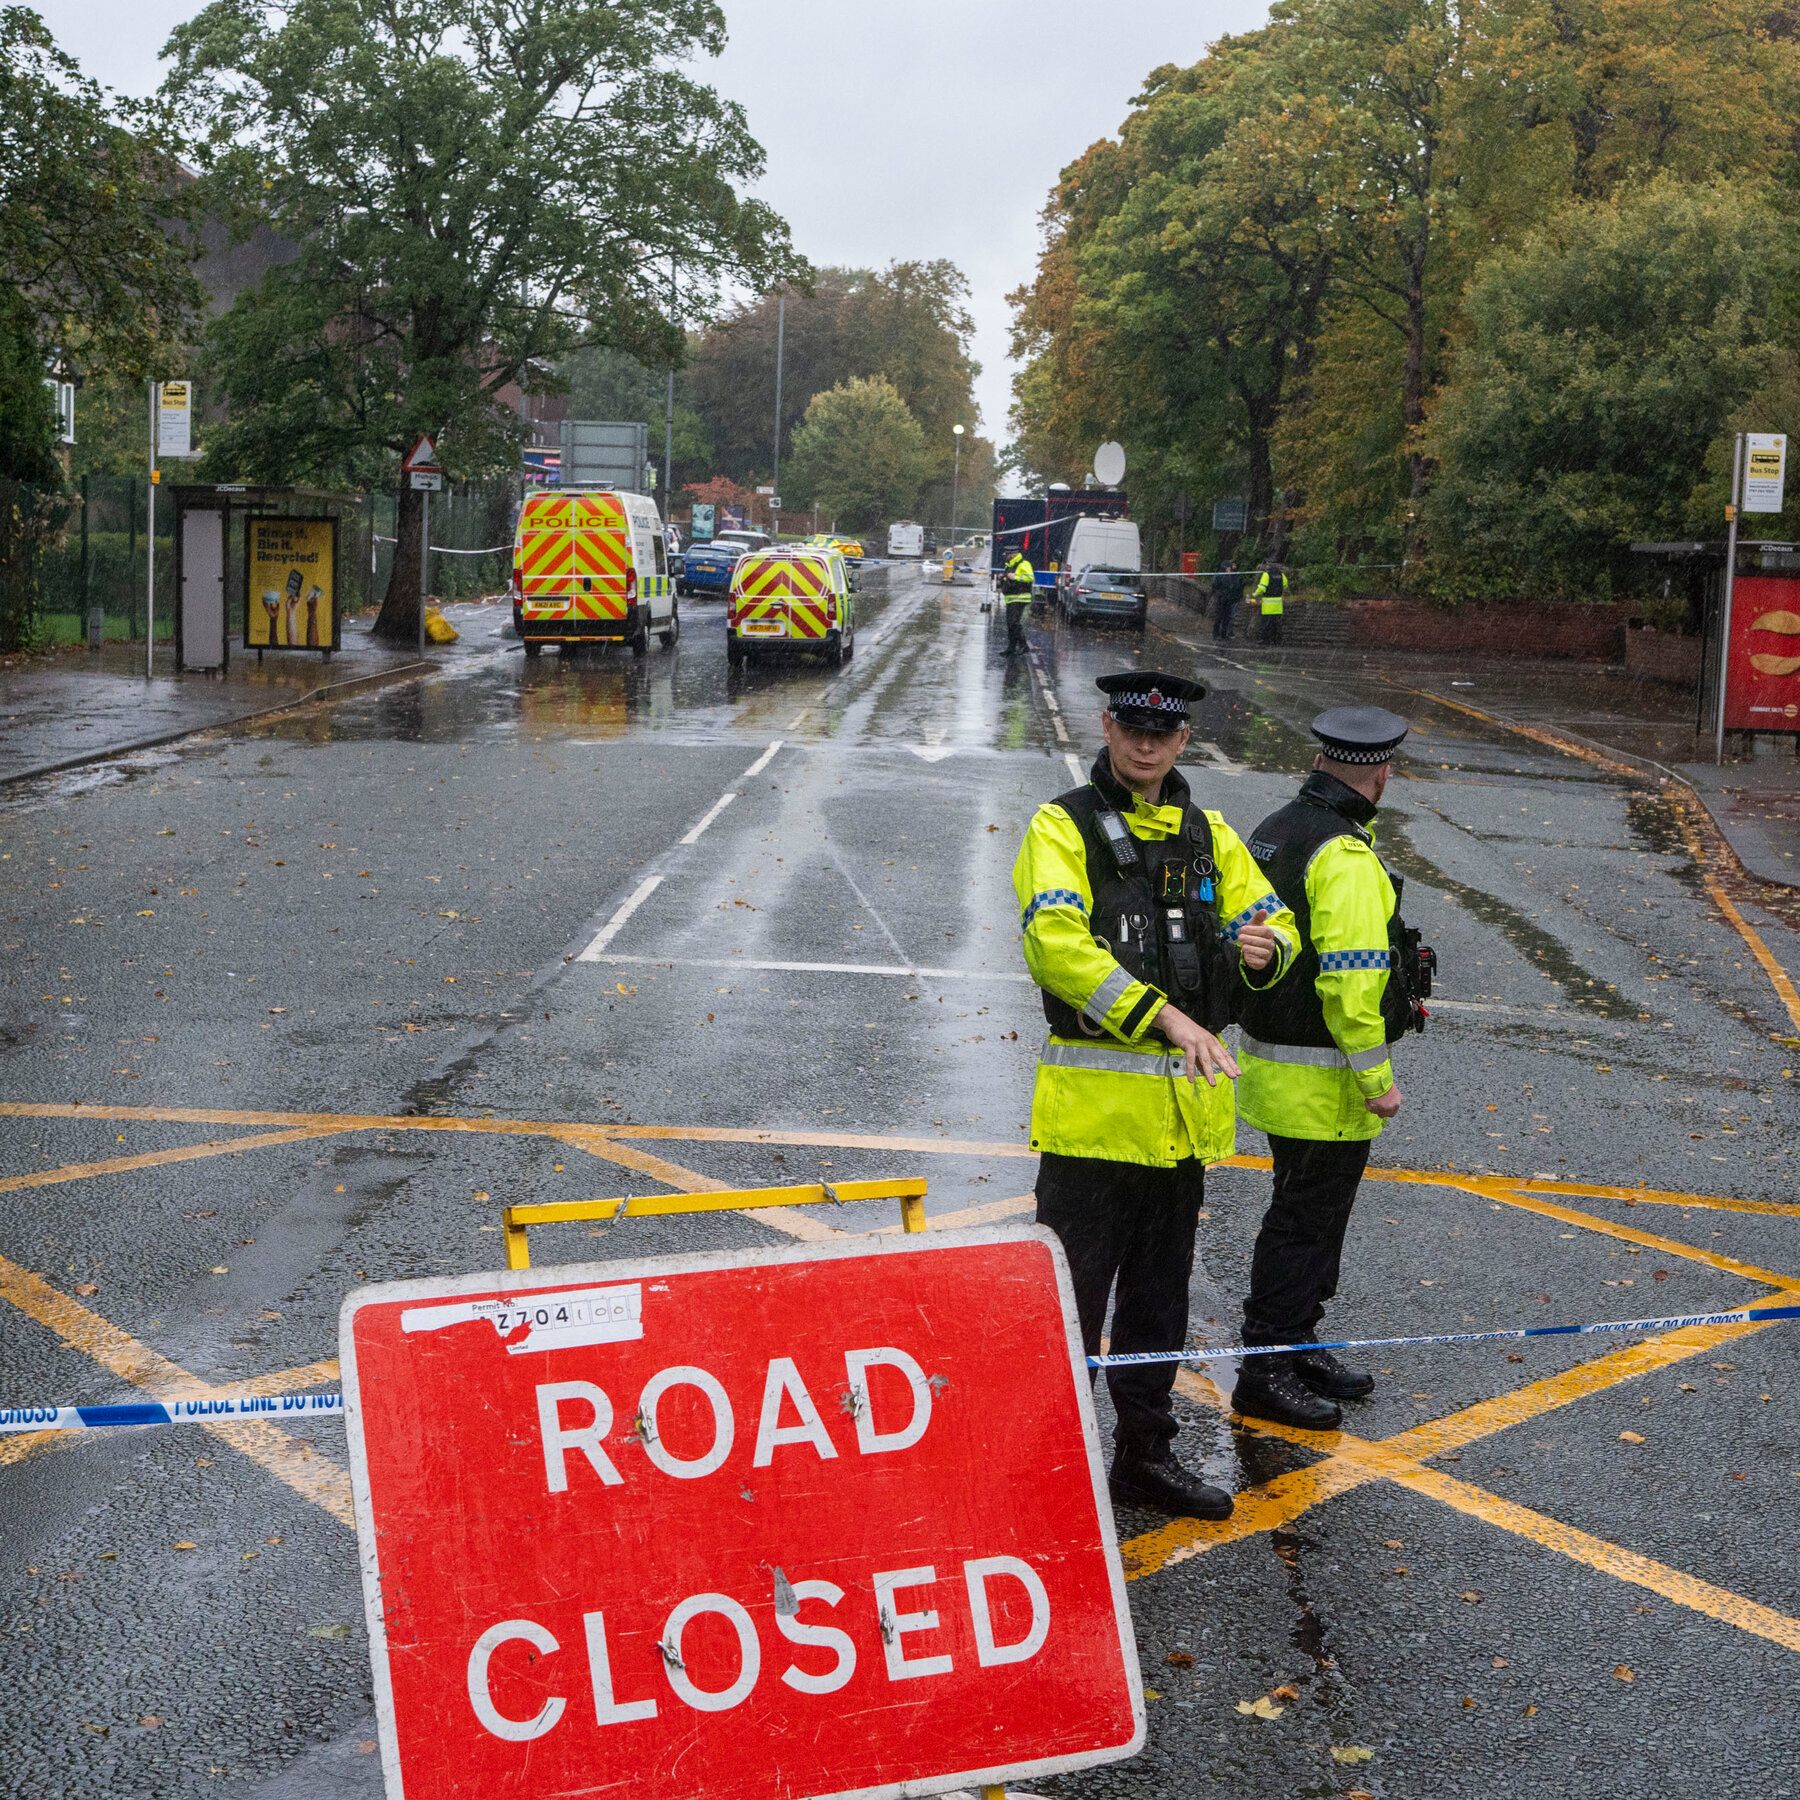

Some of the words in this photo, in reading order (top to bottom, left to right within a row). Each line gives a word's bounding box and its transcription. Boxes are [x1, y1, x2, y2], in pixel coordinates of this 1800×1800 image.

[1764, 467, 1779, 475] Stop
[529, 517, 618, 528] POLICE
[632, 515, 650, 528] POLICE
[257, 539, 278, 549] Bin
[281, 539, 293, 549] it.
[257, 551, 318, 564] Recycled!
[1250, 845, 1274, 861] POLICE
[472, 1302, 499, 1311] Permit
[175, 1399, 234, 1415] POLICE
[240, 1397, 277, 1412] LINE
[283, 1395, 306, 1410] DO
[535, 1346, 933, 1494] ROAD
[467, 1555, 1051, 1743] CLOSED
